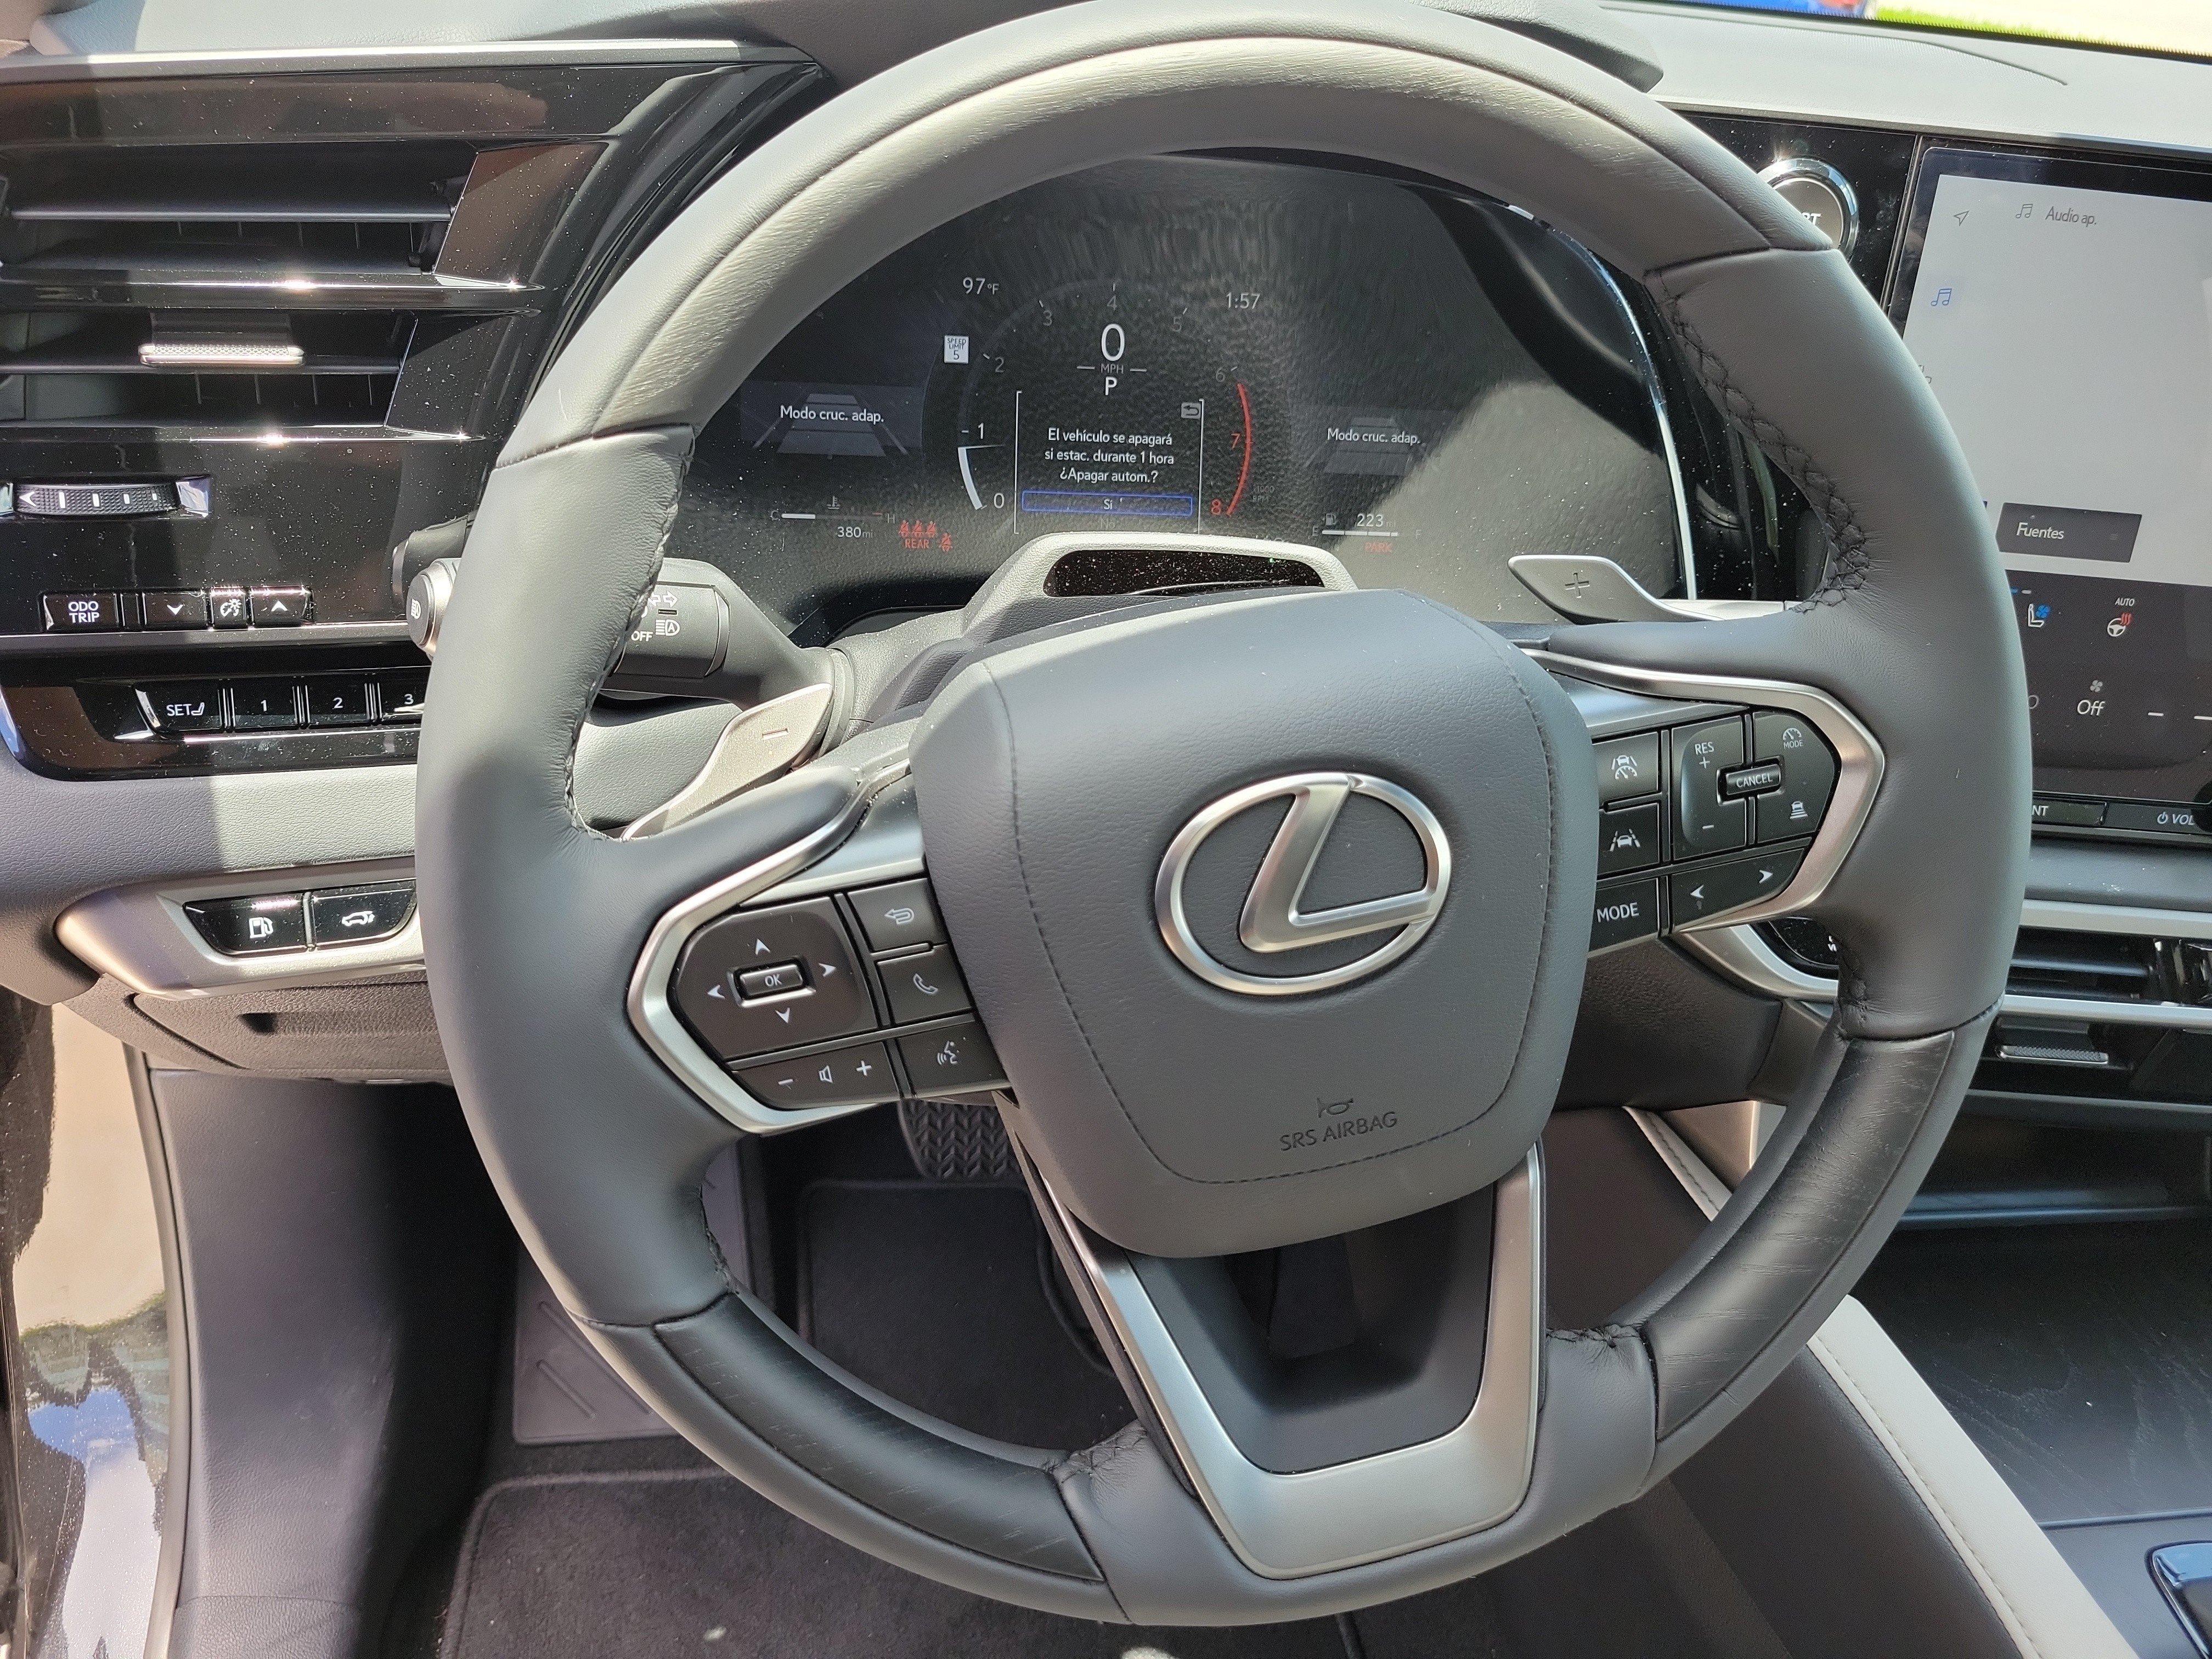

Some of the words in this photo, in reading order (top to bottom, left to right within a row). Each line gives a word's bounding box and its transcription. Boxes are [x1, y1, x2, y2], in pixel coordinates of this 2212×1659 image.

[2045, 206, 2079, 222] Audio
[2081, 215, 2097, 228] ap.
[1107, 295, 1118, 311] 4
[1226, 291, 1261, 310] 1:57
[1043, 310, 1052, 326] 3
[1172, 317, 1182, 332] 5
[1101, 323, 1125, 362] 0
[953, 350, 960, 360] 5
[995, 357, 1005, 373] 2
[1101, 363, 1124, 375] MPH
[1215, 367, 1226, 382] 6
[1105, 376, 1118, 396] P
[780, 404, 816, 420] Modo
[819, 410, 849, 421] cruc.
[851, 408, 884, 425] adap.
[978, 423, 984, 439] 1
[1048, 427, 1059, 441] El
[1062, 428, 1110, 443] vehículo
[1113, 434, 1125, 443] se
[1128, 433, 1172, 448] apagará
[1327, 427, 1359, 441] Modo
[1362, 433, 1387, 443] cruc.
[1391, 431, 1421, 447] adap.
[1231, 433, 1240, 449] 7
[1045, 448, 1053, 460] si
[1057, 449, 1090, 461] estac.
[1093, 449, 1137, 463] durante
[1140, 451, 1146, 464] 1
[1149, 451, 1175, 465] hora
[1060, 467, 1109, 484] ¿Apagar
[1111, 470, 1159, 483] autom.?
[994, 493, 1005, 509] 0
[1211, 499, 1221, 515] 8
[2016, 522, 2064, 540] Fuentes
[905, 538, 929, 549] REAR
[68, 601, 99, 612] ODO
[2114, 597, 2136, 607] AUTO
[69, 612, 100, 623] TRIP
[631, 630, 653, 641] OFF
[260, 699, 267, 712] 1
[333, 697, 343, 709] 2
[404, 693, 414, 705] 3
[2077, 699, 2106, 715] Off
[166, 703, 191, 716] SET
[1694, 741, 1714, 755] RES
[1783, 740, 1804, 750] MODE
[1736, 773, 1773, 788] CANCEL
[1596, 901, 1640, 923] MODE
[764, 973, 783, 987] OK
[1279, 1129, 1317, 1151] SRS
[1322, 1111, 1398, 1142] AIRBAG
